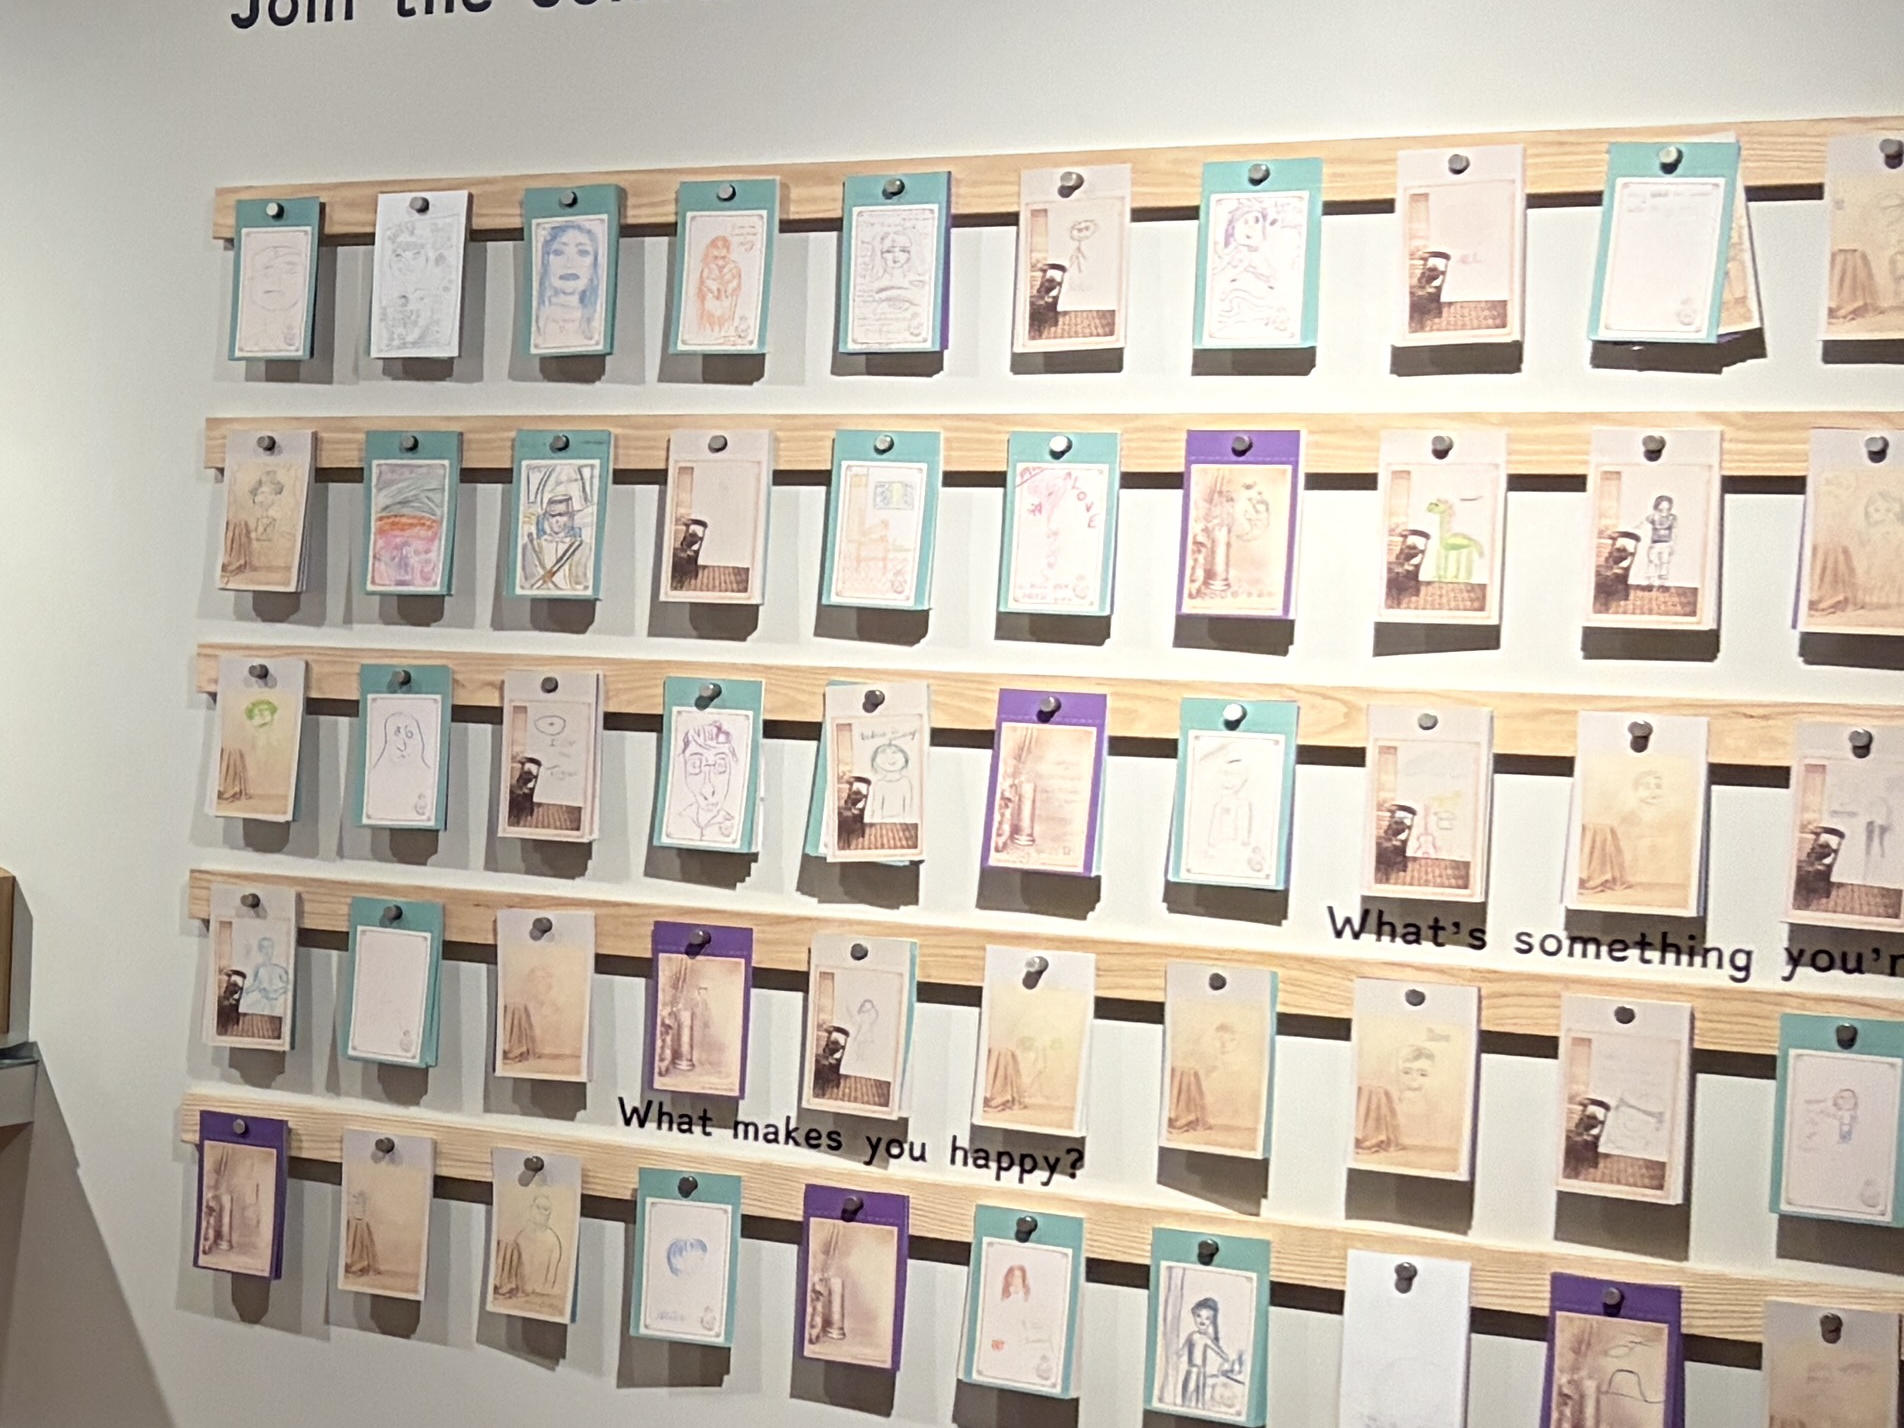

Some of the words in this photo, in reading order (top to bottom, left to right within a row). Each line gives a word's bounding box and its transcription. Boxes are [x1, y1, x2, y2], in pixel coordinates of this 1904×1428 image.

[1326, 904, 1488, 951] What's
[1513, 929, 1754, 983] something
[616, 1096, 714, 1138] What
[731, 1115, 843, 1151] makes
[862, 1132, 928, 1165] you
[949, 1135, 1086, 1187] happy?
